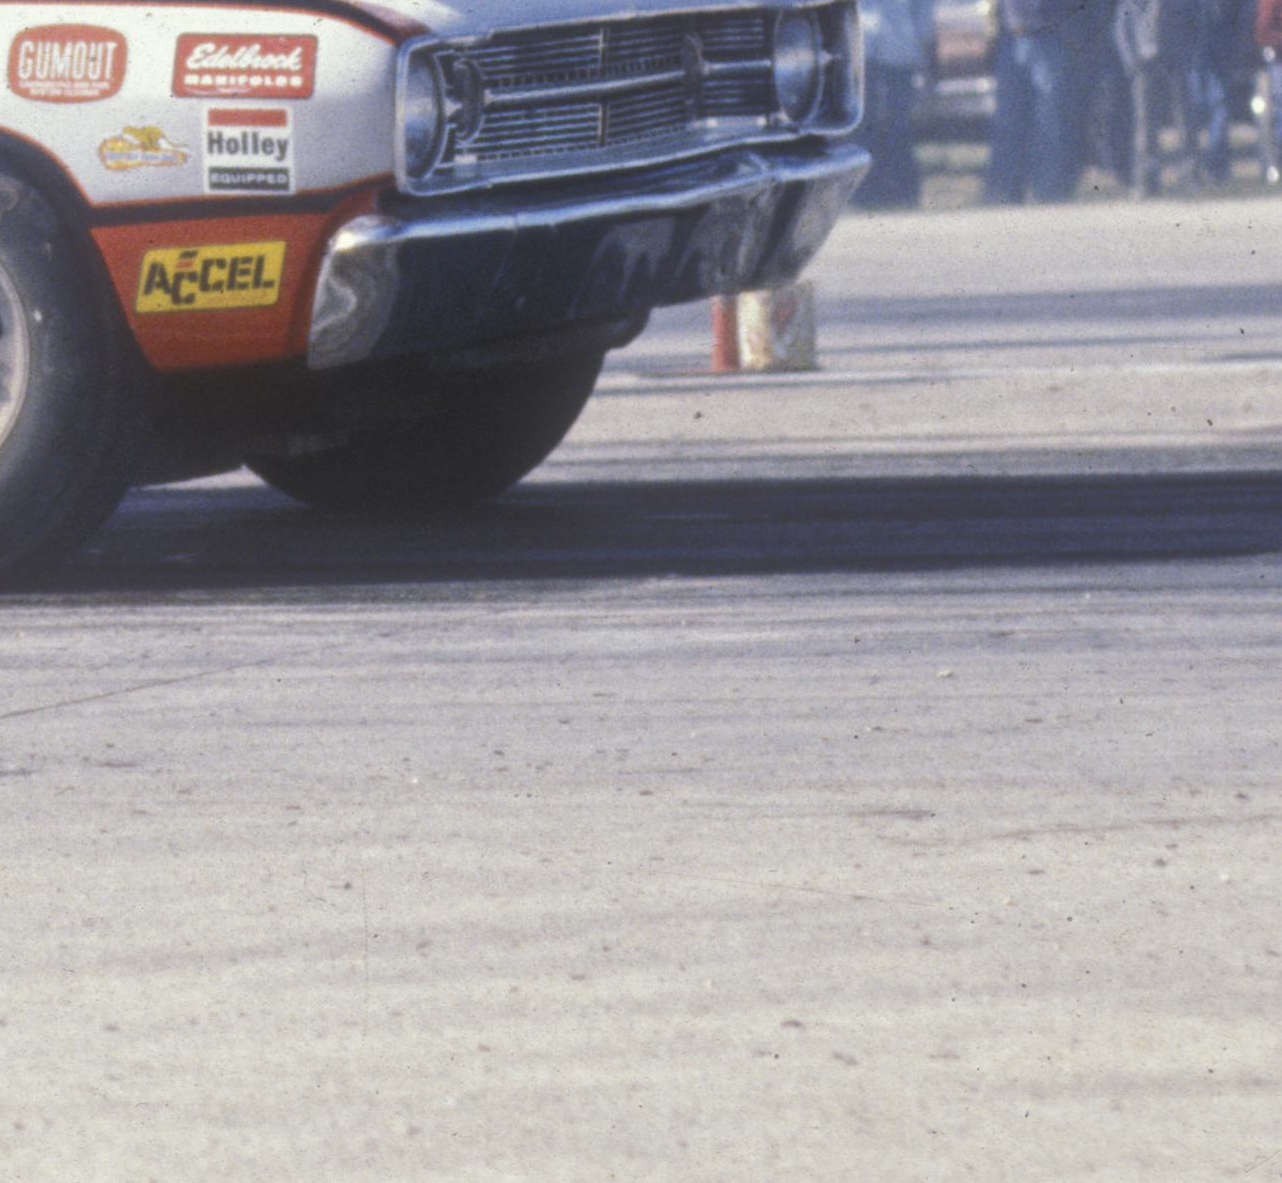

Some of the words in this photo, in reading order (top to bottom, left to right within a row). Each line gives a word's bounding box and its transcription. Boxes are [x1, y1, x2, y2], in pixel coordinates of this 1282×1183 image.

[18, 40, 118, 80] GUMOUT
[185, 42, 303, 71] Edelbrock
[207, 130, 290, 161] Holley
[209, 171, 288, 185] EQUIPPED
[143, 250, 276, 305] ACCEL
